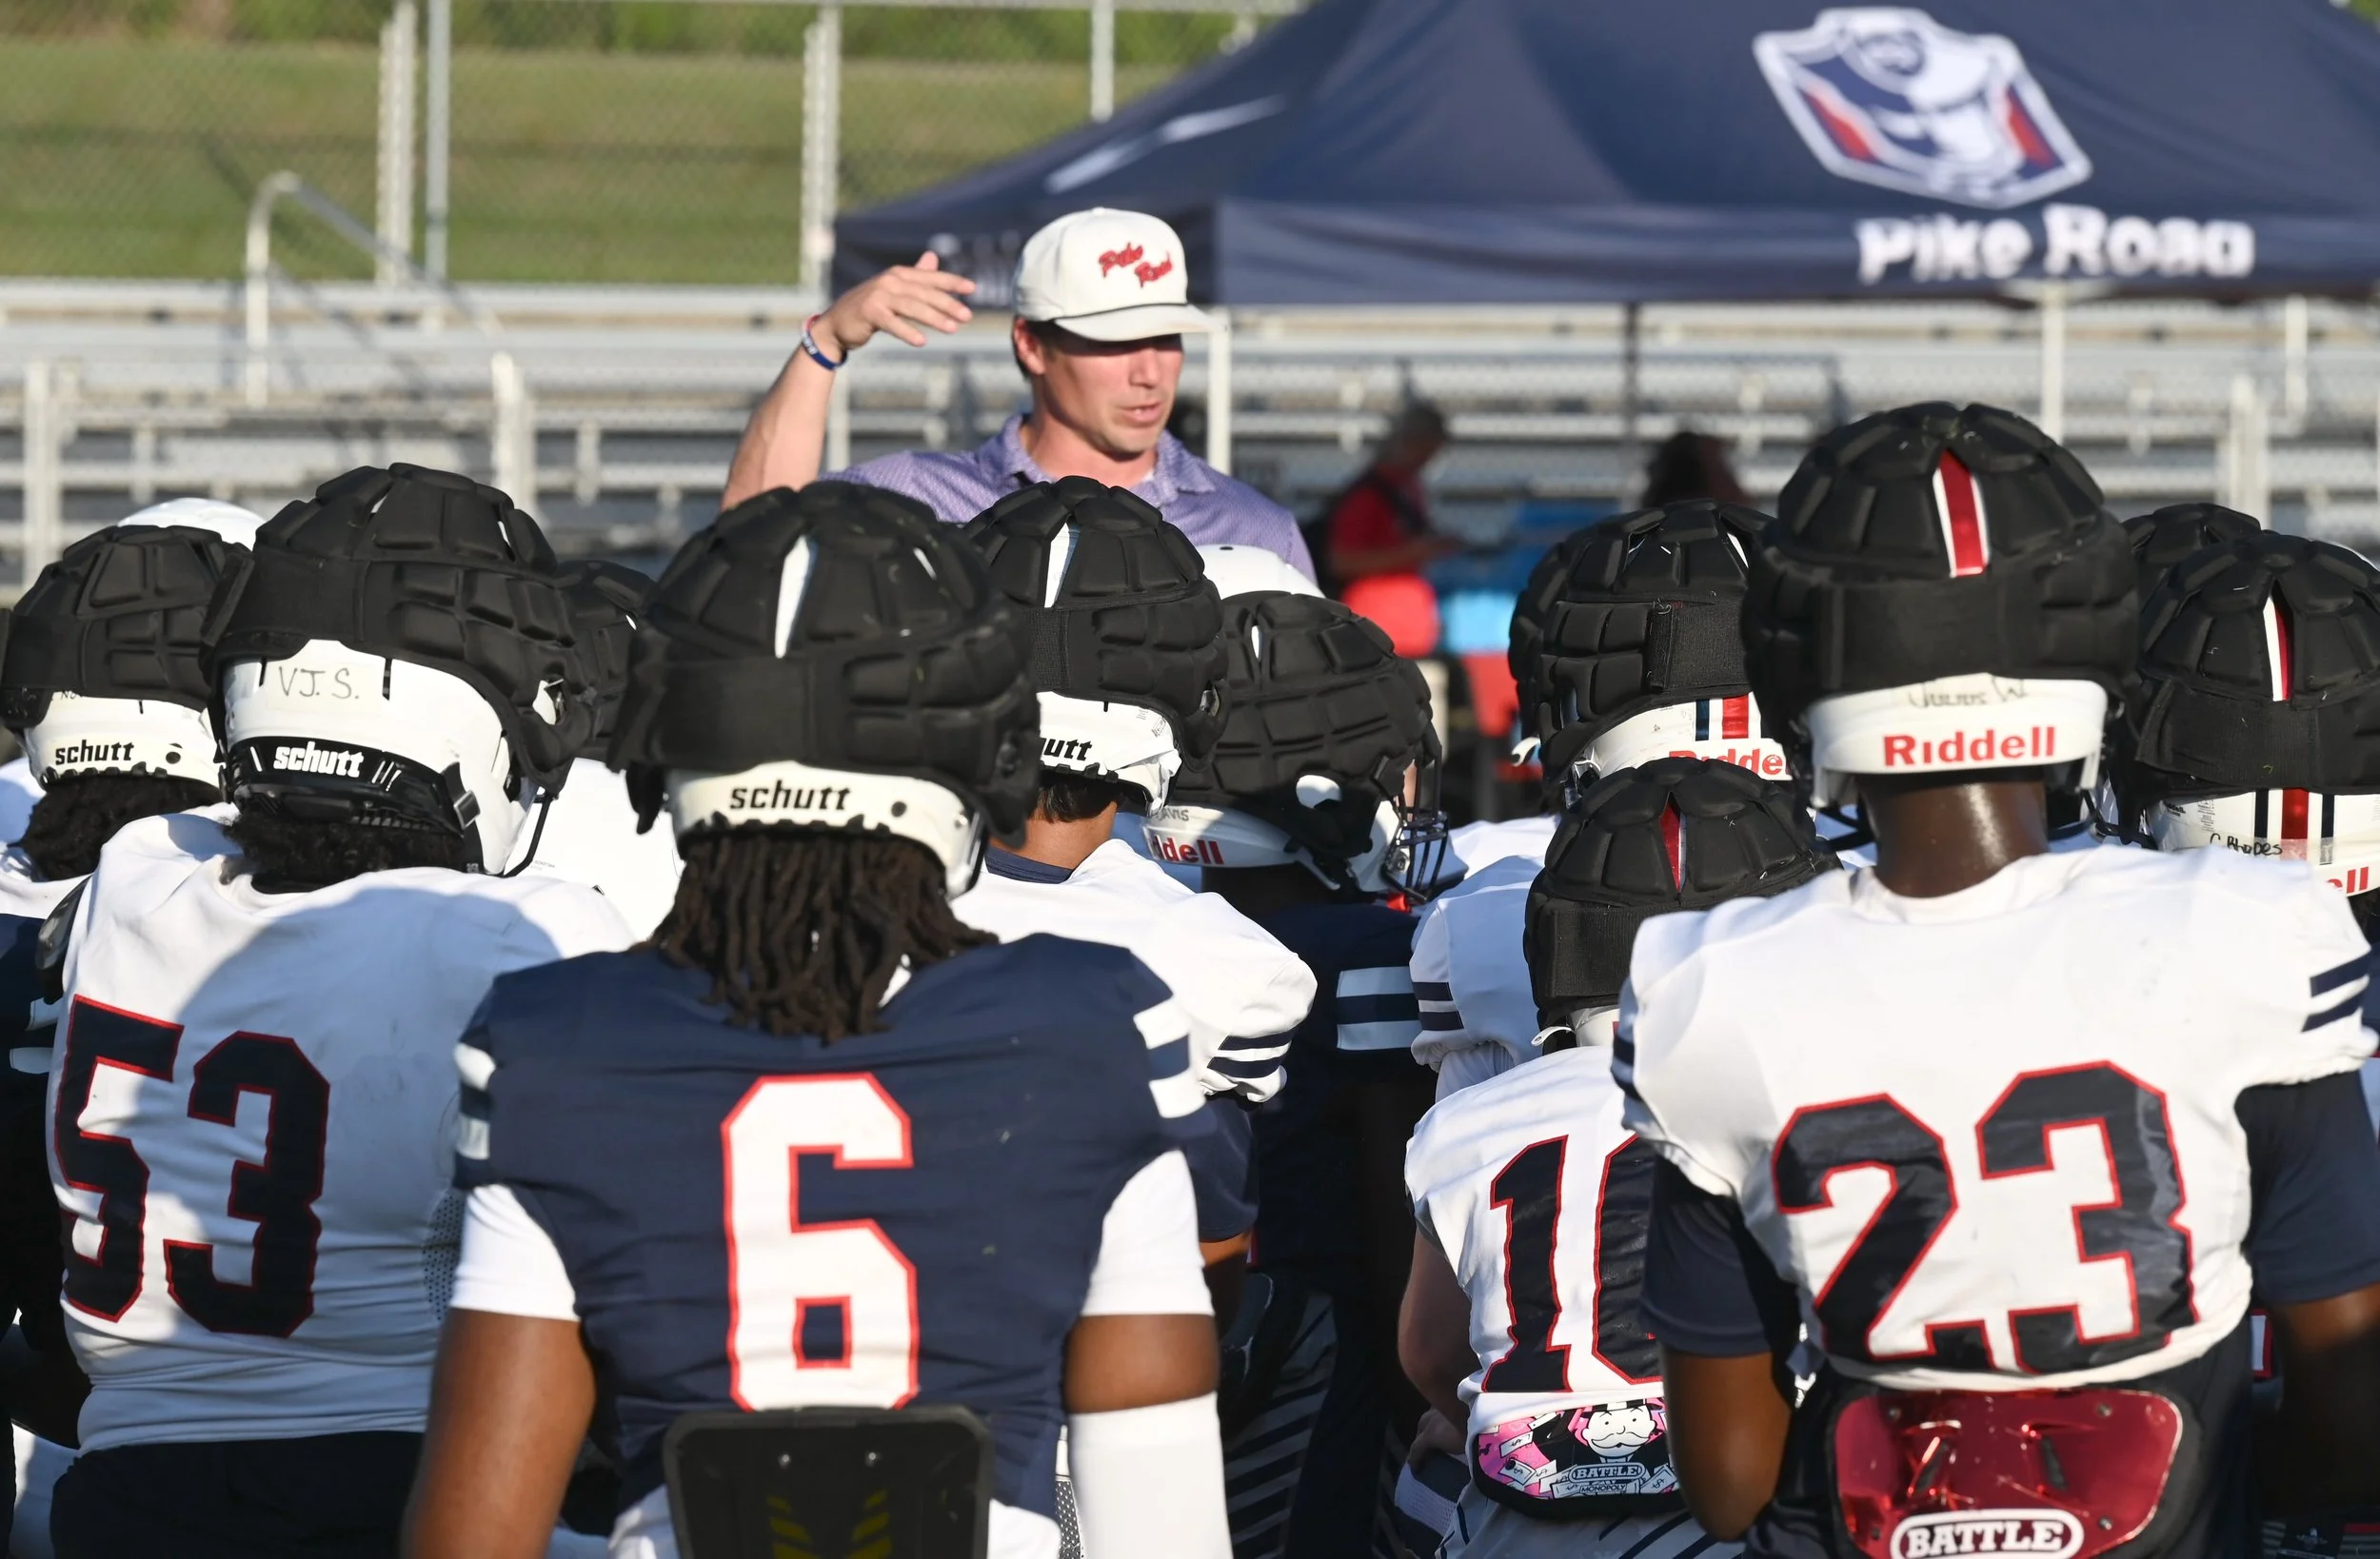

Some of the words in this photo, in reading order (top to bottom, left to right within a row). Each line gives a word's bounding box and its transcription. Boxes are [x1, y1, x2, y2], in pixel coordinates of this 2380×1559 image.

[1855, 213, 2033, 284] Pike
[55, 739, 134, 765] schutt
[272, 740, 364, 779] schutt
[1043, 738, 1093, 761] utt
[1884, 726, 2055, 767] Riddell
[730, 779, 850, 811] schutt
[54, 994, 330, 1334] 53
[1771, 1059, 2201, 1376] 23
[721, 1072, 920, 1412] 6
[1577, 1466, 1638, 1479] BATTLE
[1580, 1484, 1626, 1492] MONOPOLY
[1905, 1521, 2065, 1559] BATTLE
